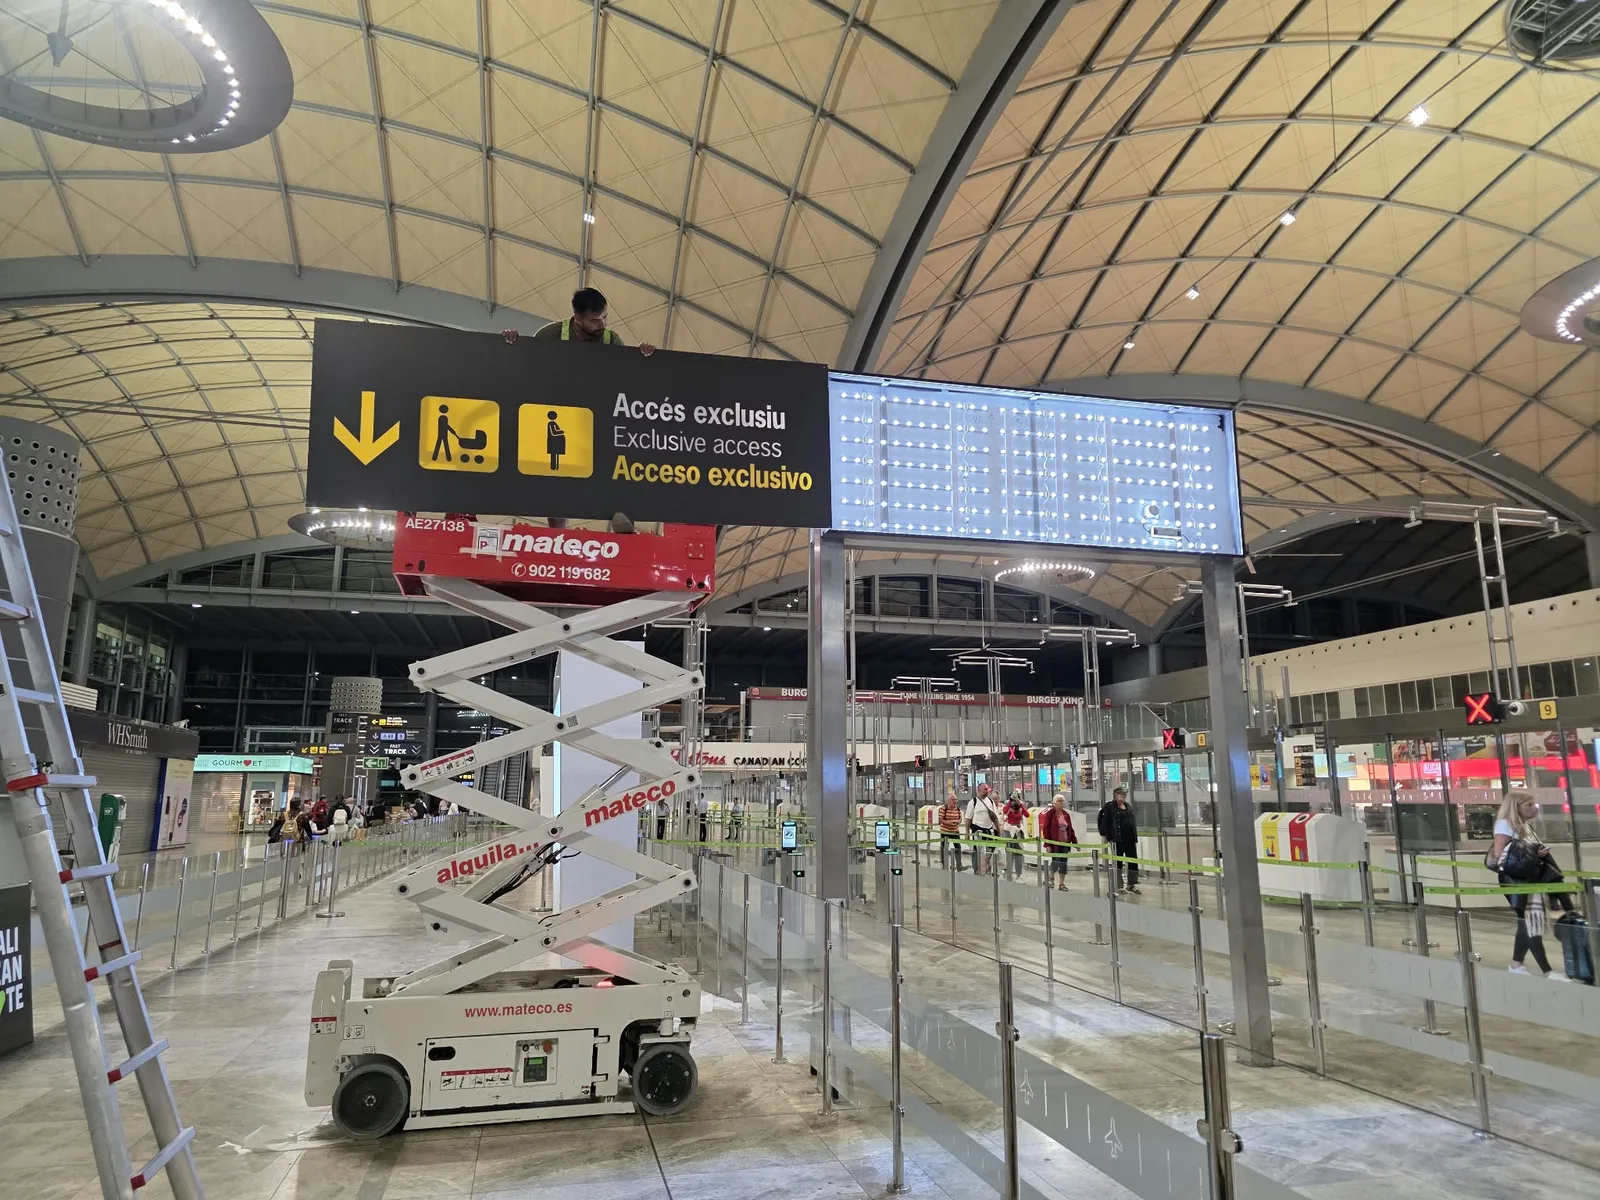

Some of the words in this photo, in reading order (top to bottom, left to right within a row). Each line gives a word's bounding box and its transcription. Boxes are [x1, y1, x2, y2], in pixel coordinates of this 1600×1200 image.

[612, 392, 686, 422] Accés
[693, 402, 786, 430] exclusiu
[613, 426, 707, 453] Exclusive
[713, 437, 783, 458] access
[612, 455, 700, 485] Acceso
[708, 463, 813, 491] exclusivo
[404, 517, 466, 533] AE27138
[502, 531, 620, 559] mateco
[529, 564, 556, 578] 902
[559, 566, 581, 580] 119
[584, 566, 611, 582] 682
[781, 687, 808, 697] BURG
[1026, 695, 1061, 705] BURGER
[1062, 696, 1085, 705] KING
[1544, 704, 1552, 716] 9
[108, 722, 148, 749] WHSmith
[733, 756, 785, 766] CANADAN
[585, 779, 676, 828] mateco
[0, 954, 23, 986] AN
[464, 1001, 573, 1018] www.mateco.es
